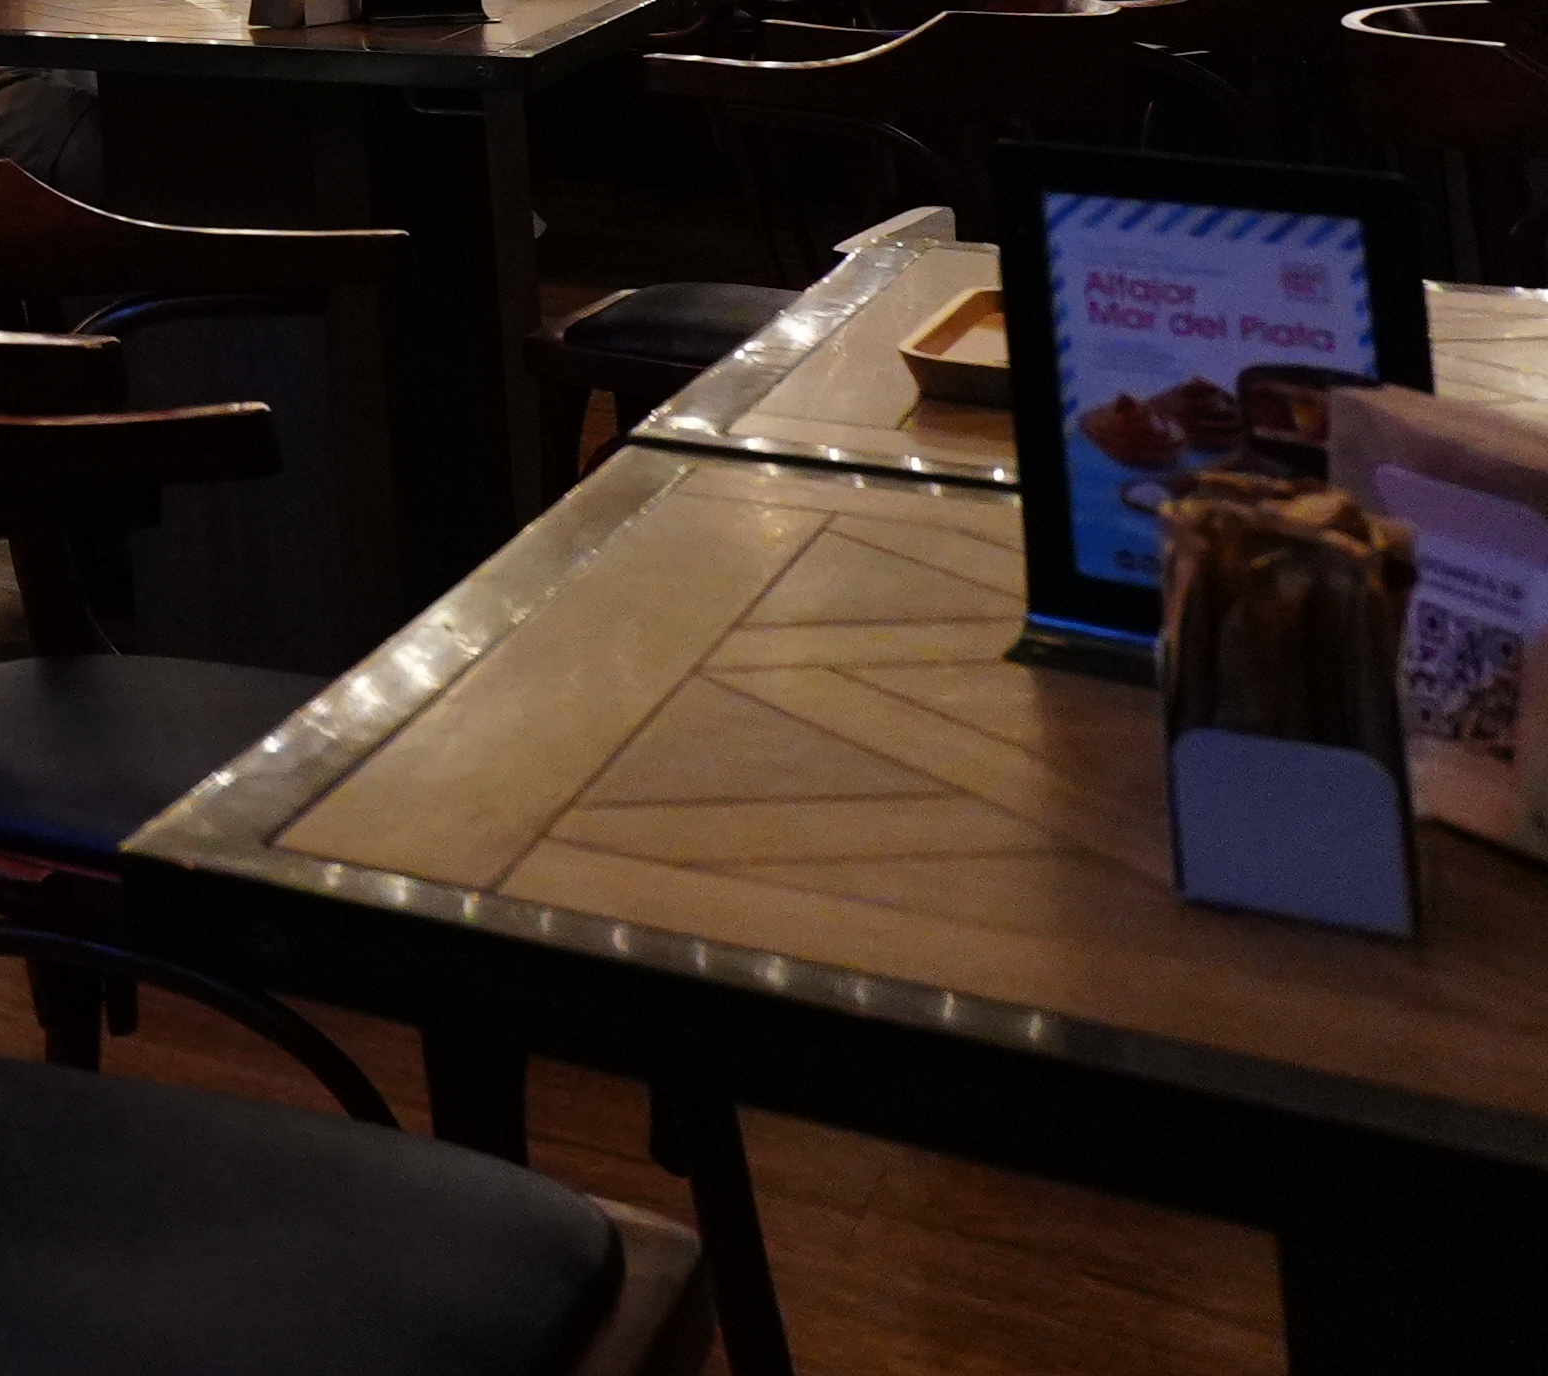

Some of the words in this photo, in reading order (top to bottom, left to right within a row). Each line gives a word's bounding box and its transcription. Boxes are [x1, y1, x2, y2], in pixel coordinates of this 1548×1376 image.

[1084, 270, 1198, 309] Alfajor
[1086, 298, 1156, 331] Mar
[1168, 310, 1228, 340] del
[1238, 314, 1336, 355] Plata
